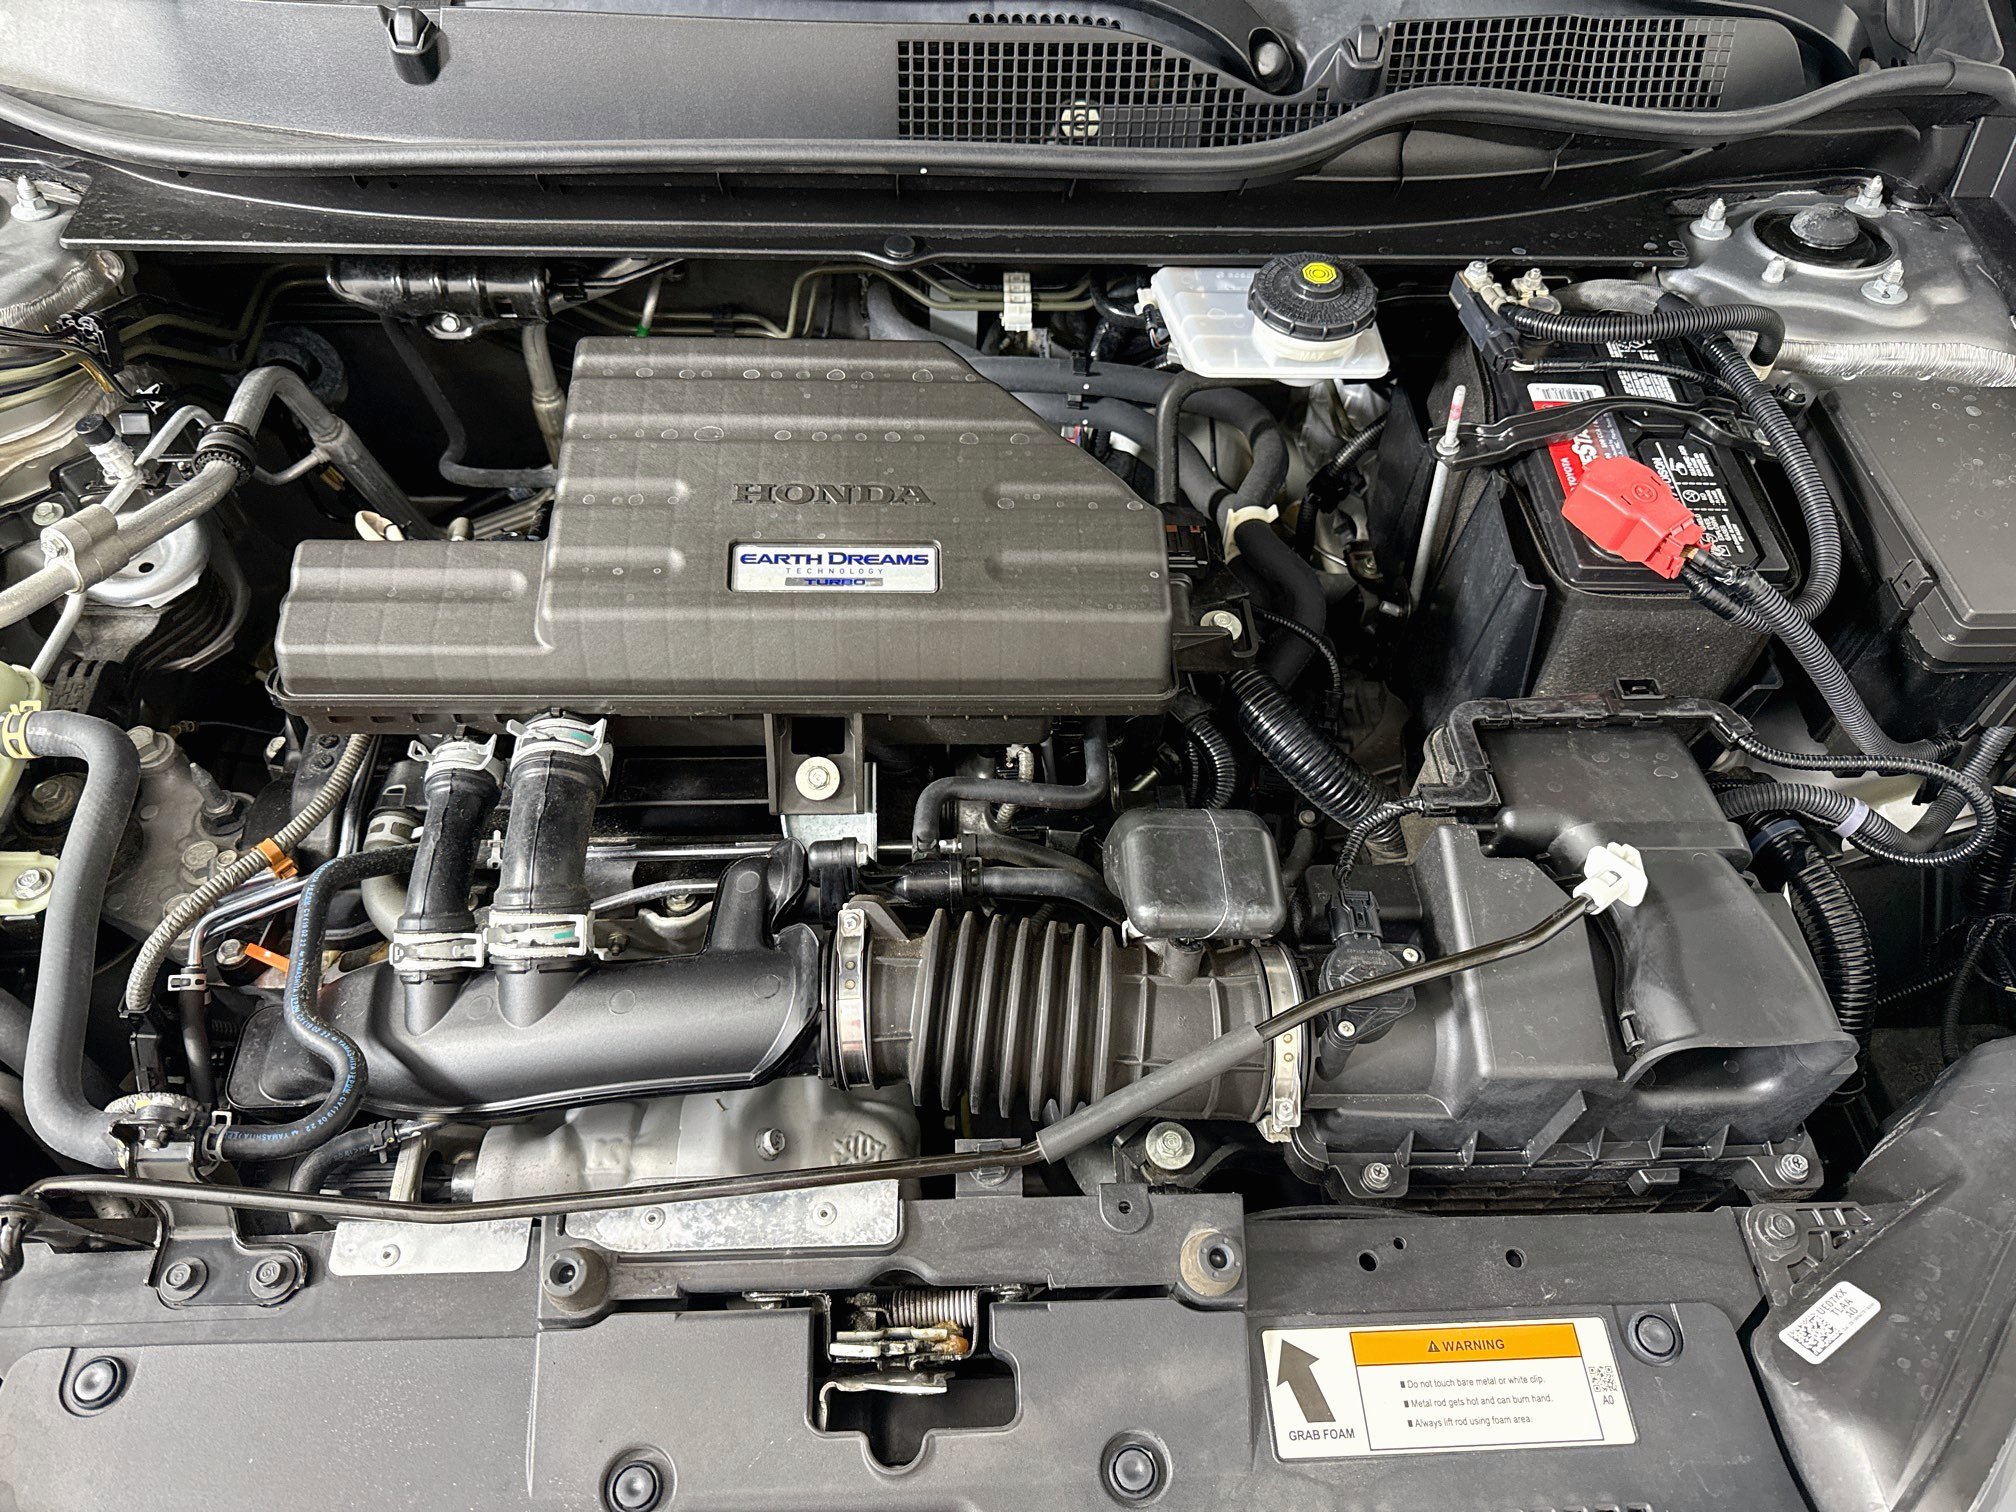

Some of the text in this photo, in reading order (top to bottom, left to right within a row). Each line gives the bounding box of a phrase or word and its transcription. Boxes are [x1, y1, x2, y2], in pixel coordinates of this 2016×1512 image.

[733, 483, 936, 505] HONDA
[740, 552, 929, 565] EARTH DREAMS
[1442, 1339, 1505, 1352] WARNING
[1407, 1375, 1546, 1388] Do not touch bare metal or white clip.
[1411, 1393, 1554, 1408] Metal rod gets hot and can burn hand.
[1415, 1415, 1533, 1429] Always lift rod using foam area.
[1288, 1427, 1356, 1442] GRAB FOAM
